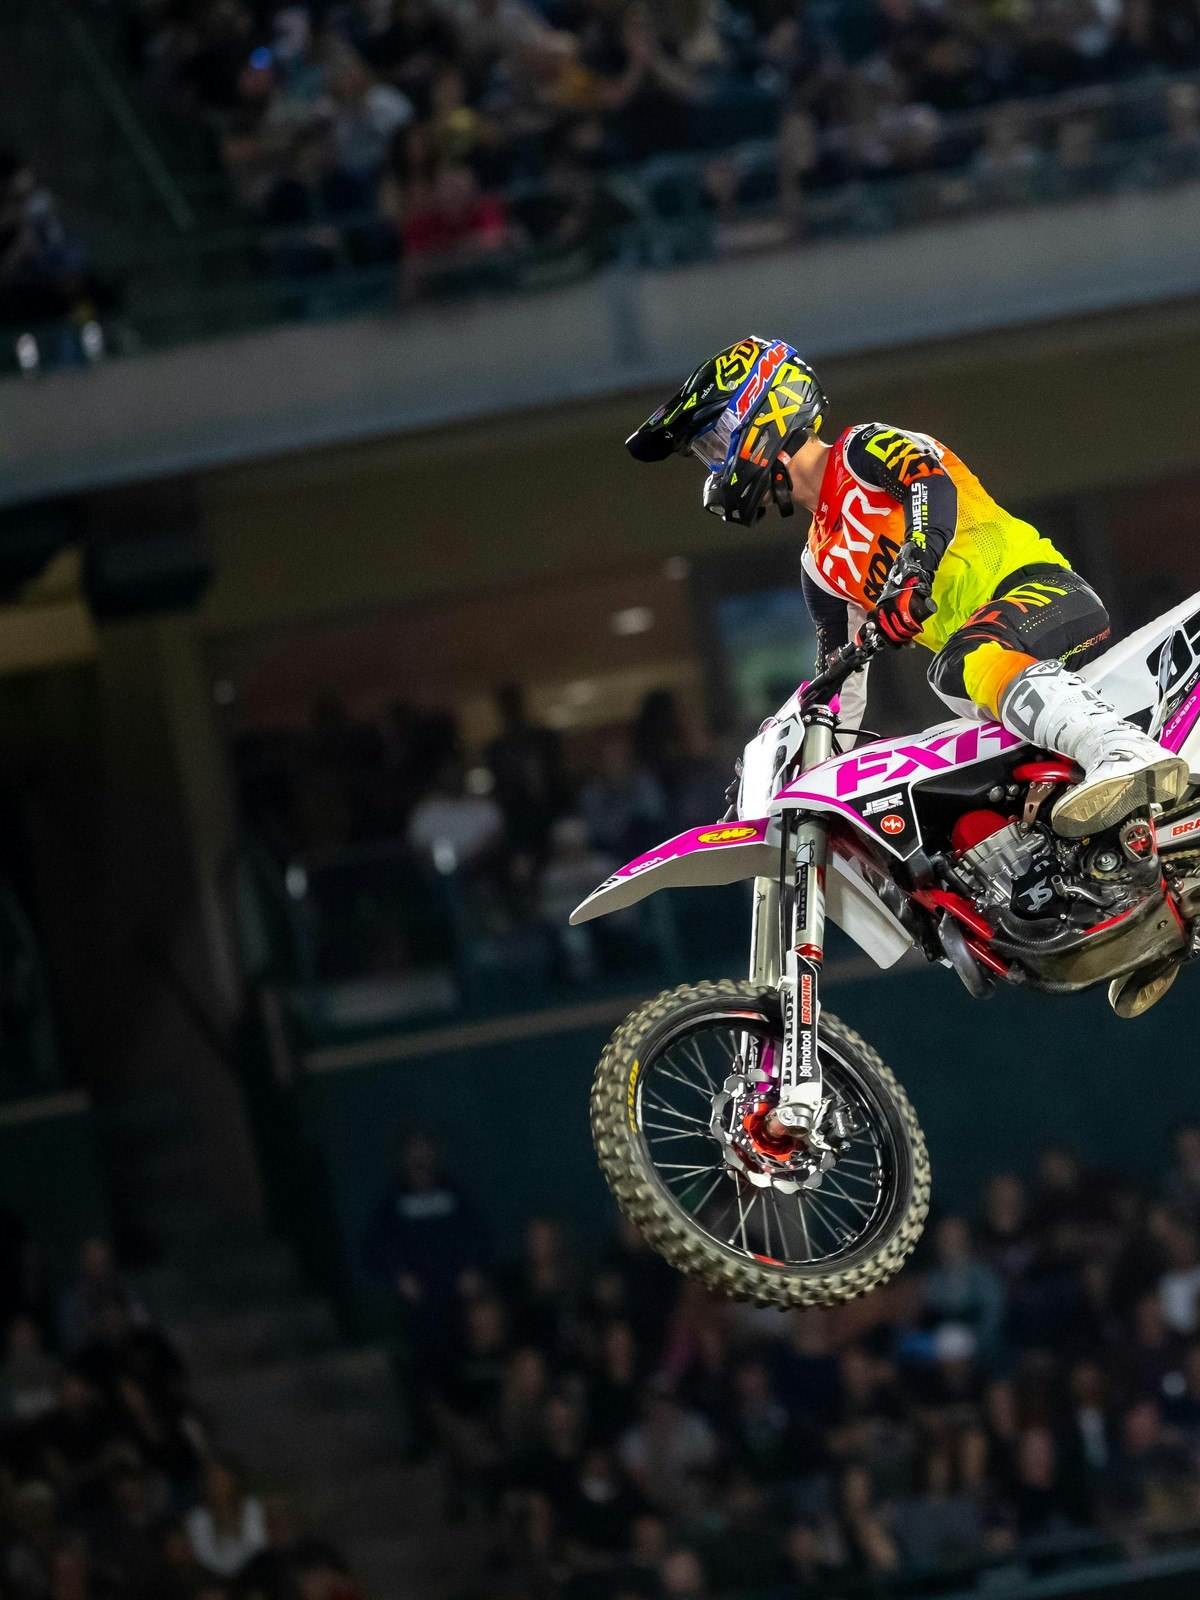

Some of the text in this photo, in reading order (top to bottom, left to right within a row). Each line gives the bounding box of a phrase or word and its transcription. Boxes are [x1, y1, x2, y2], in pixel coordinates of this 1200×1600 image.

[736, 343, 788, 421] FMF
[699, 827, 757, 842] FMF
[802, 974, 812, 1024] BRAKING
[801, 1030, 812, 1067] motool
